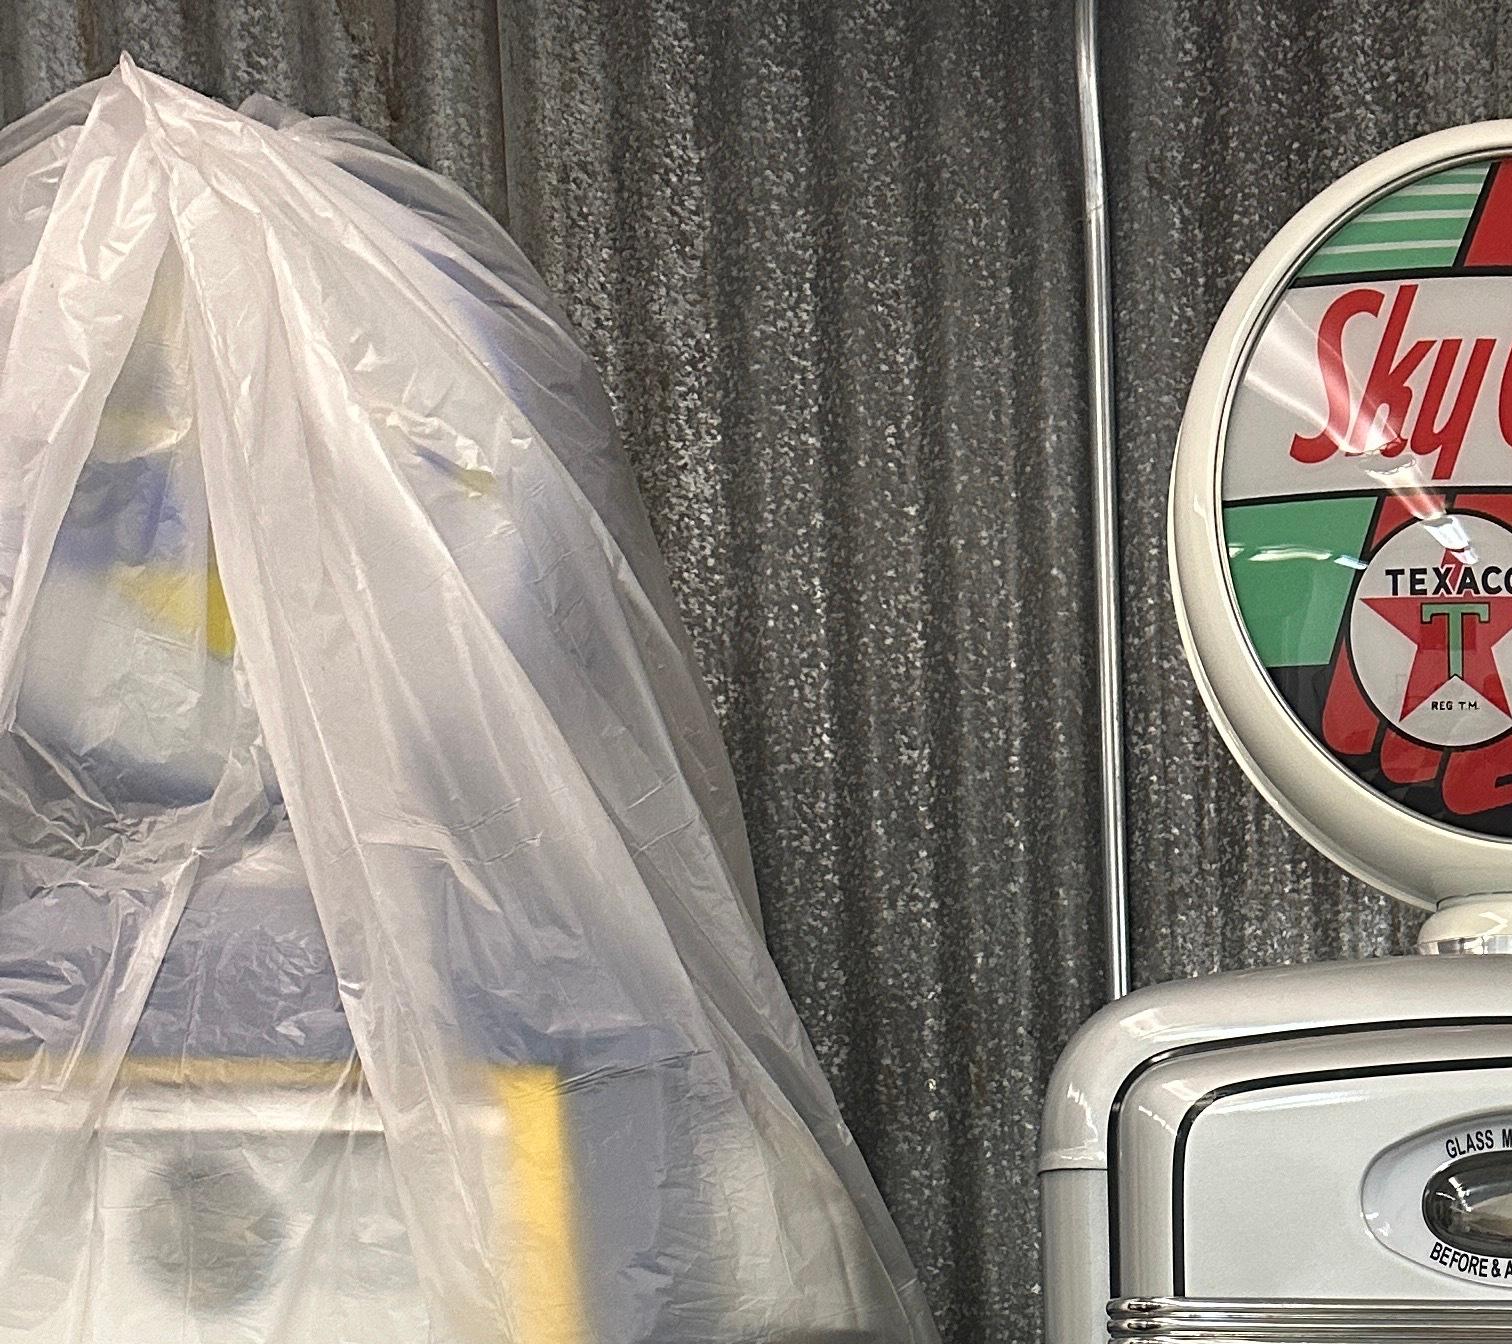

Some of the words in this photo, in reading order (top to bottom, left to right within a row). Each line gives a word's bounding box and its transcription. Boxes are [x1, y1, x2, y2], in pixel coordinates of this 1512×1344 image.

[1290, 284, 1496, 479] Sky
[1432, 701, 1453, 710] REG
[1446, 1130, 1494, 1158] GLASS
[1430, 1242, 1488, 1277] BEFORE
[1491, 1259, 1501, 1278] &
